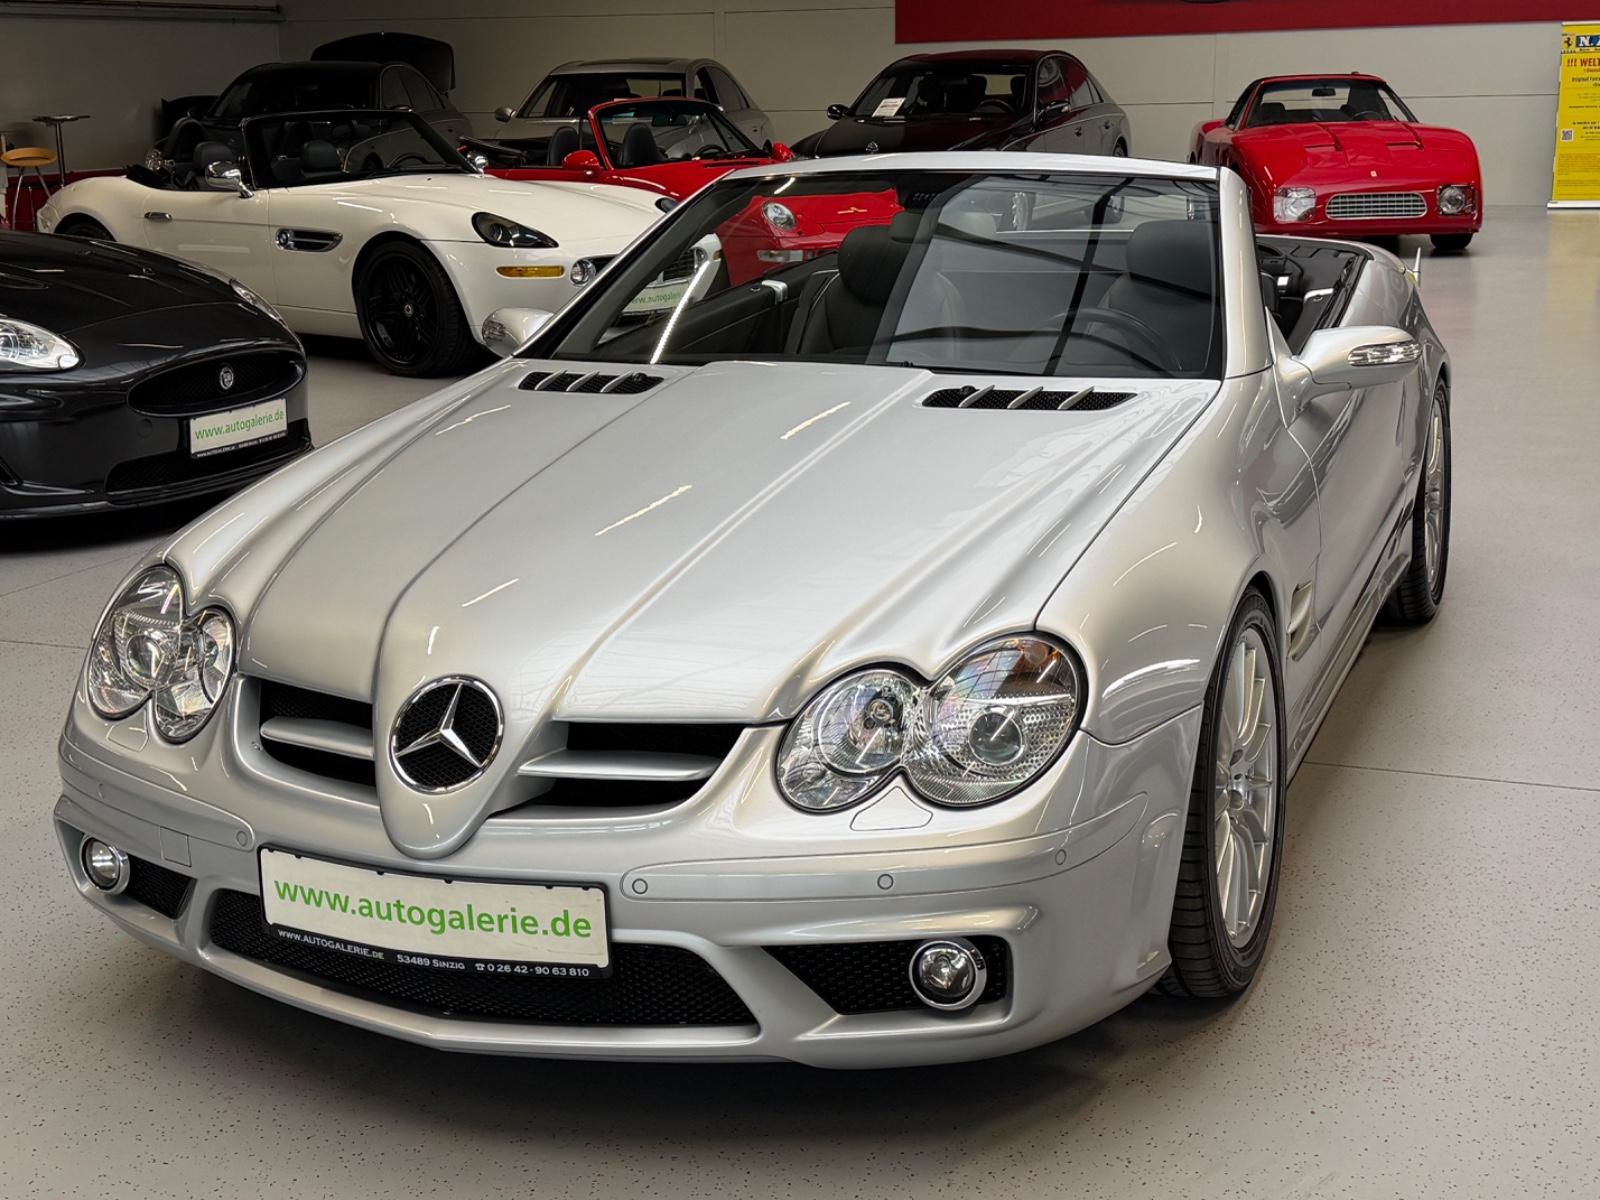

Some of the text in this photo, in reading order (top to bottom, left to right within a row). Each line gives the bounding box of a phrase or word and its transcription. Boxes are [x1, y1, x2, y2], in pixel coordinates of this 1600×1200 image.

[195, 409, 285, 440] www.autogalerie.de
[274, 879, 592, 938] www.autogalerie.de
[396, 954, 430, 966] 53489
[496, 964, 512, 973] 26
[552, 967, 567, 976] 63
[569, 968, 590, 977] 810
